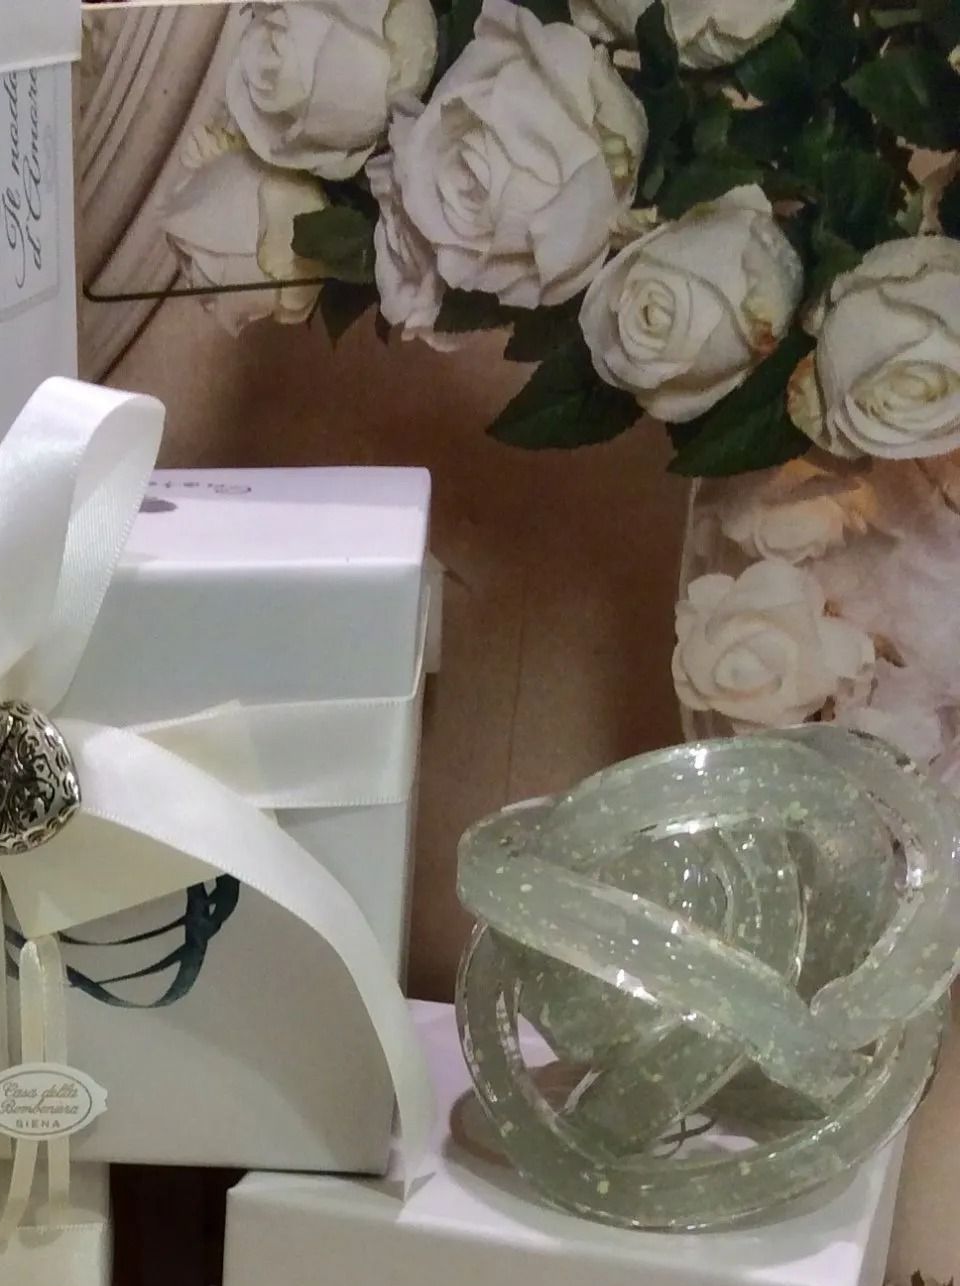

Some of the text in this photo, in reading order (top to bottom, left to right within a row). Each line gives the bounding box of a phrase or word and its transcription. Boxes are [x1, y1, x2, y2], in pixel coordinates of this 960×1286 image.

[1, 186, 27, 290] Il
[1, 1081, 39, 1099] Casa
[14, 1119, 62, 1130] SIENA
